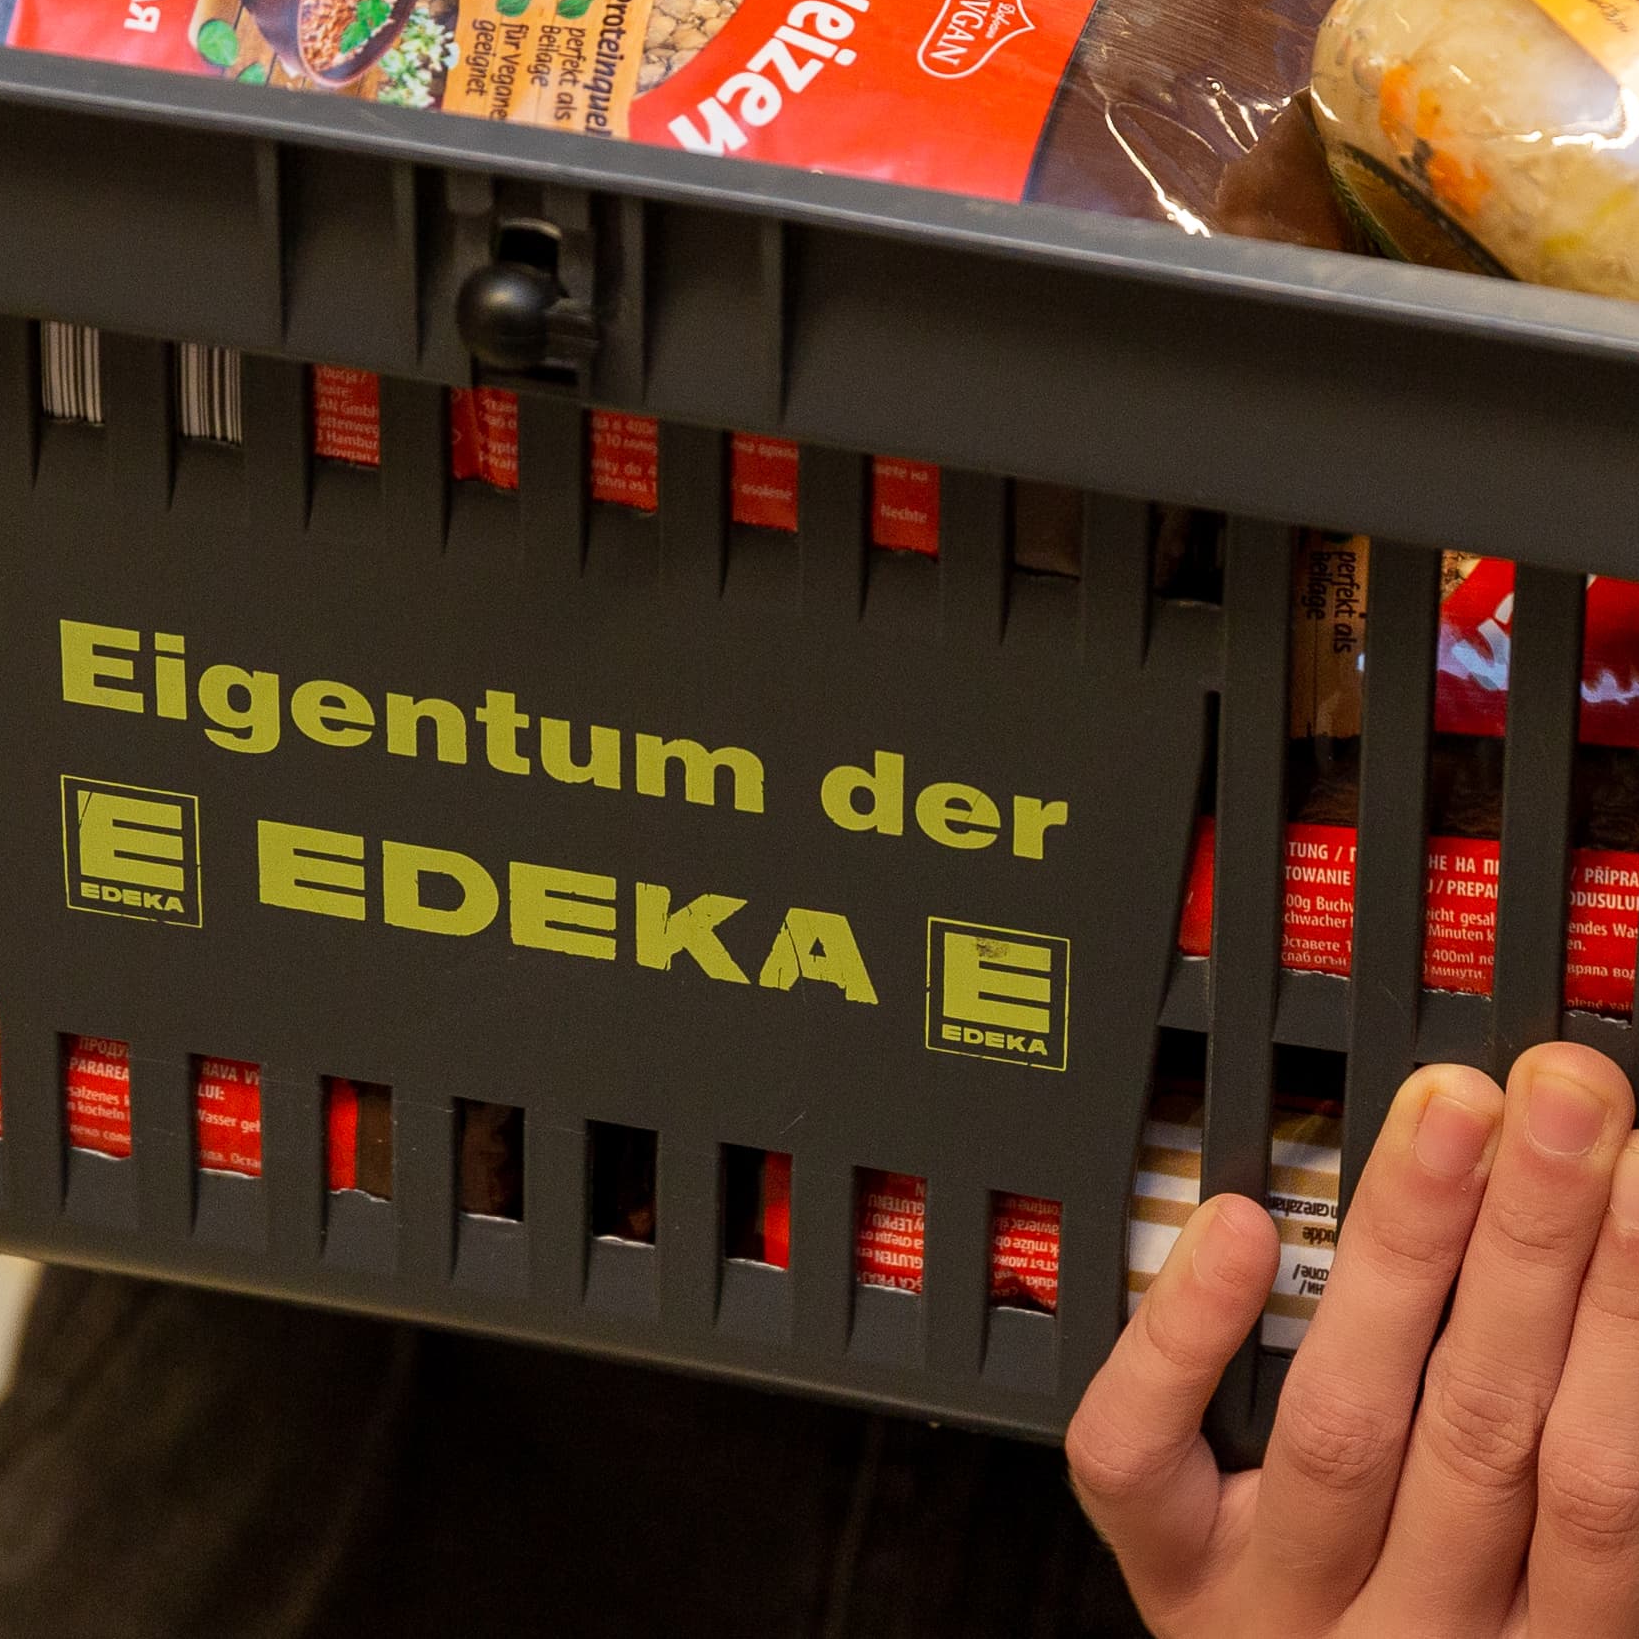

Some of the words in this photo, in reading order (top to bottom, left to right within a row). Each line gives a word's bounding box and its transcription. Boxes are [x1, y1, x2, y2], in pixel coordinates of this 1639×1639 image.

[499, 22, 530, 52] für
[464, 18, 497, 97] geeignet
[526, 25, 562, 88] Beilage
[560, 26, 587, 87] perfekt
[554, 91, 578, 122] als
[1335, 550, 1361, 619] perfekt
[1332, 624, 1358, 655] als
[59, 618, 765, 815] Eigentum
[819, 749, 1068, 860] der
[80, 880, 186, 915] EDEKA
[257, 820, 879, 1006] EDEKA
[1285, 893, 1312, 913] 00g
[1283, 910, 1347, 929] chwacher
[1428, 923, 1484, 942] Minuten
[78, 1036, 130, 1059] ПРОДУ
[941, 1023, 1049, 1058] EDEKA
[873, 1249, 924, 1270] GLUTEN
